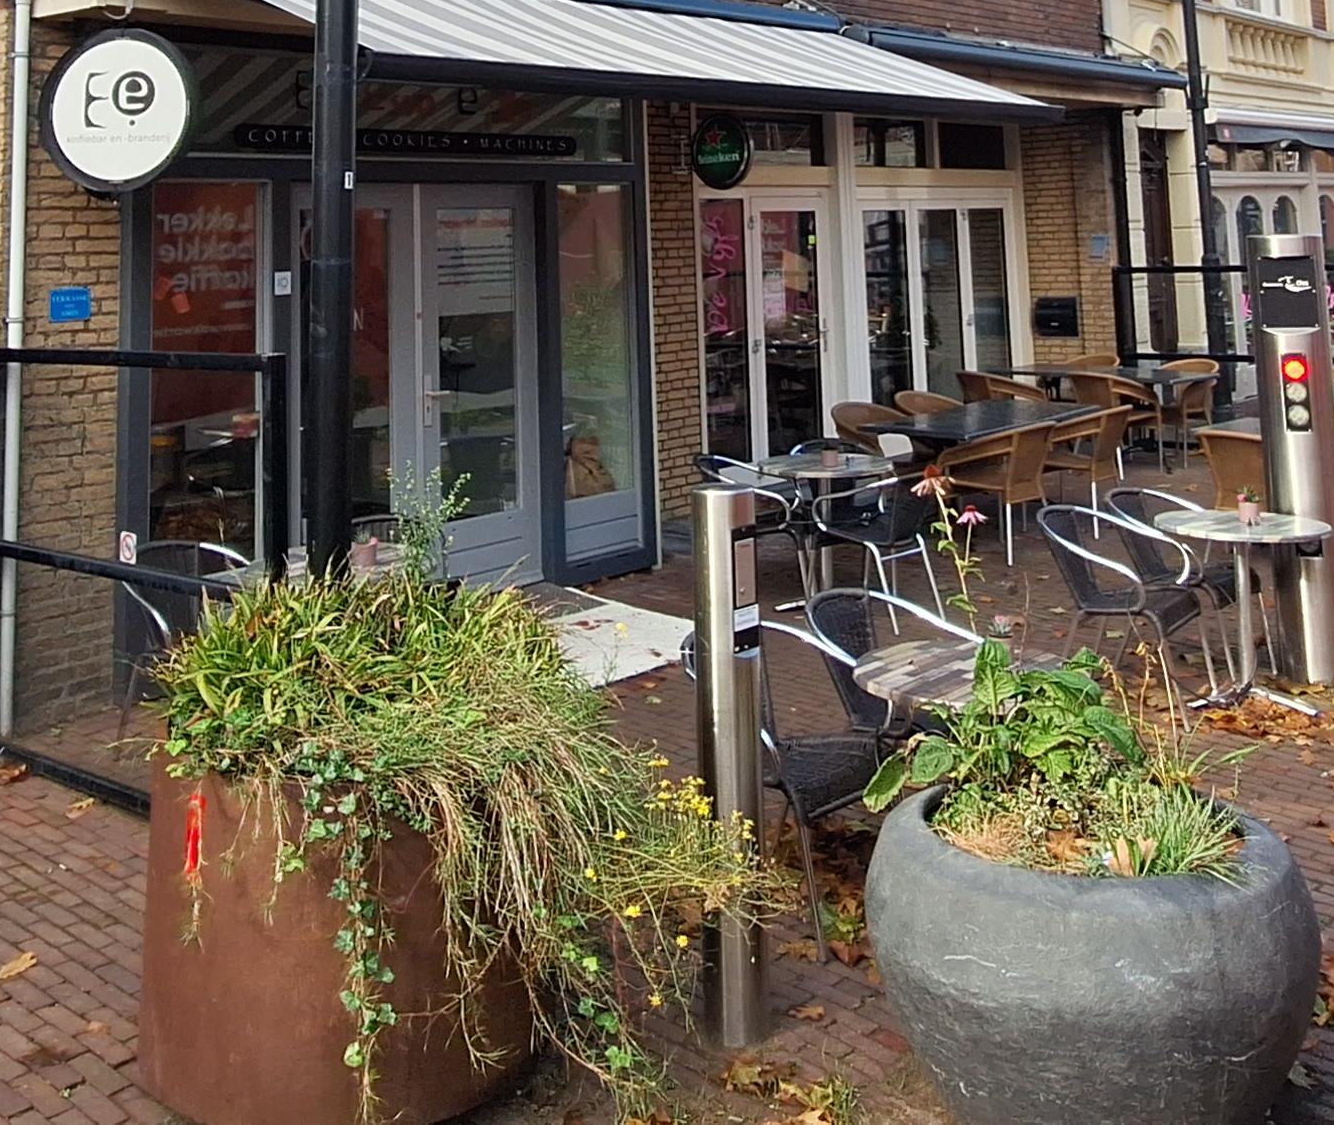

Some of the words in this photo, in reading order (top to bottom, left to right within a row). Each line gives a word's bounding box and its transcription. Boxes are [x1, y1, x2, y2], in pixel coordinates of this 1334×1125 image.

[248, 129, 313, 144] COFF
[363, 133, 451, 148] COOKIES
[480, 138, 567, 152] MACHINES
